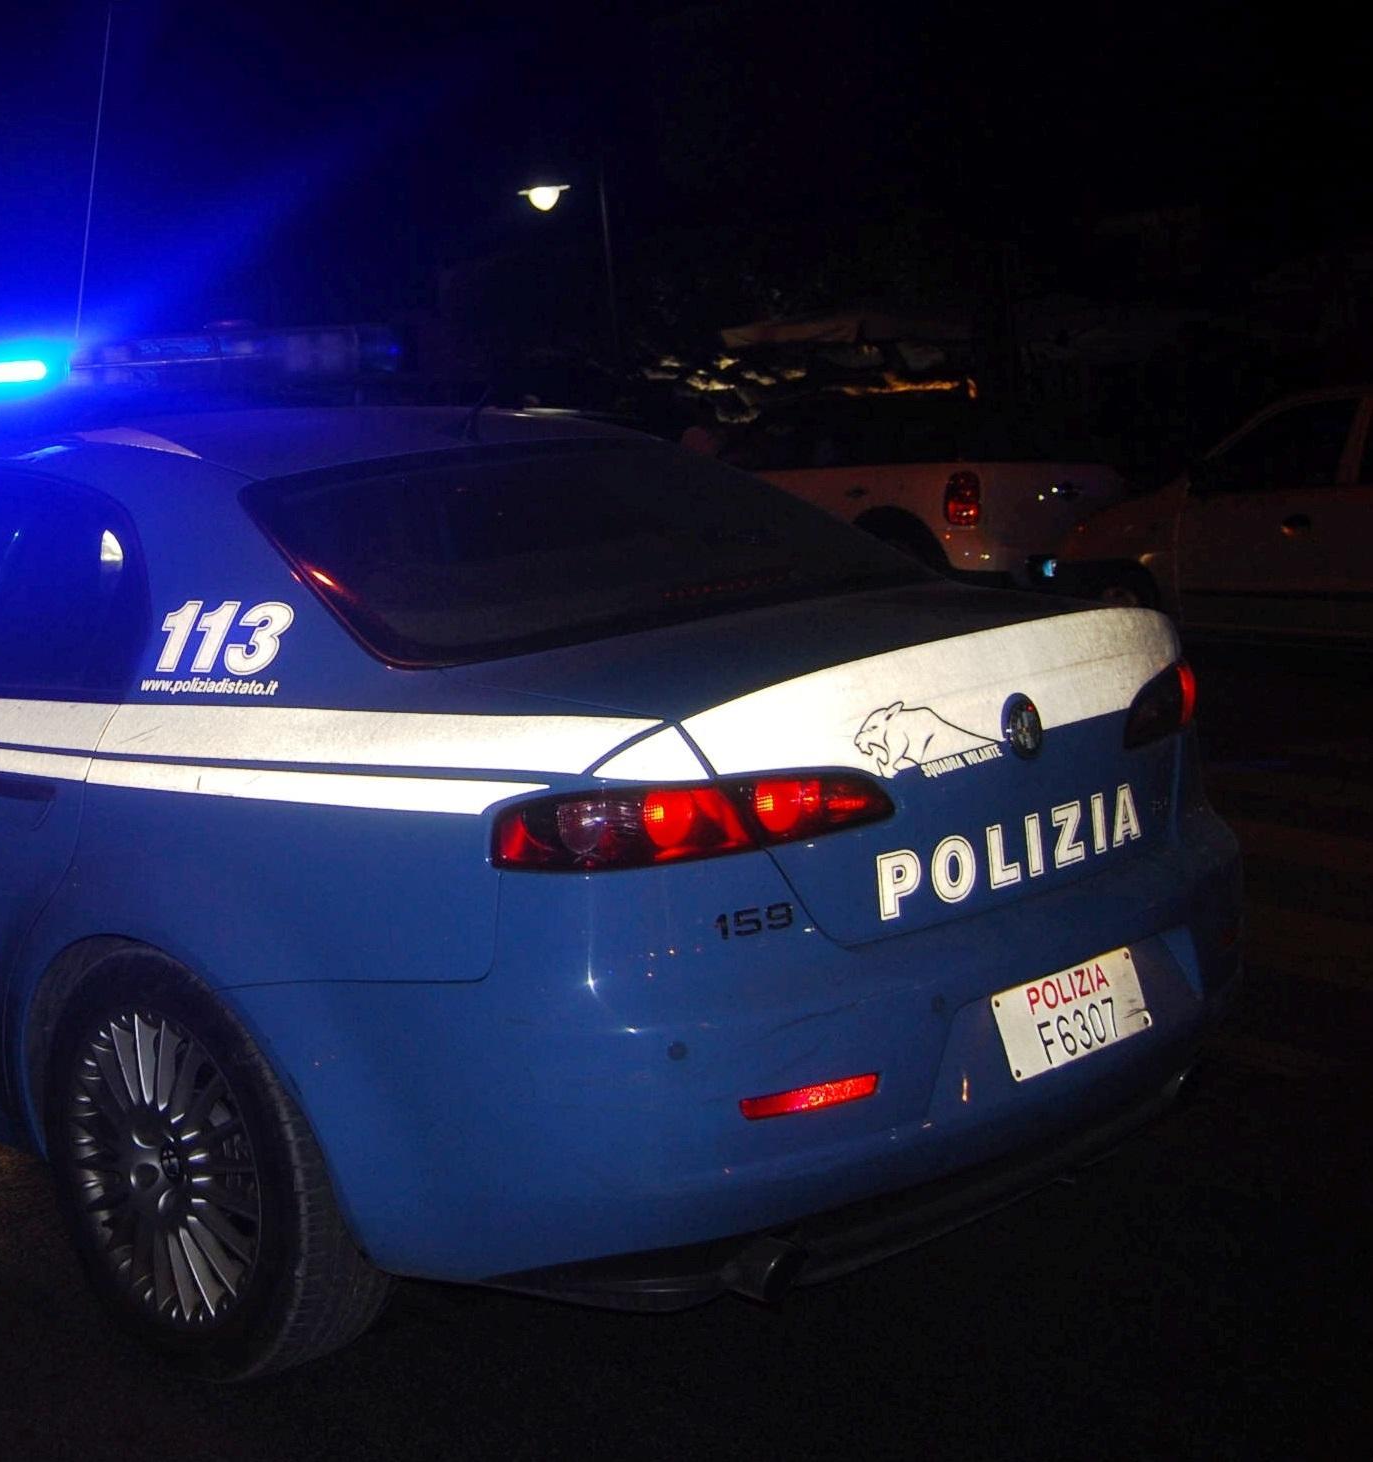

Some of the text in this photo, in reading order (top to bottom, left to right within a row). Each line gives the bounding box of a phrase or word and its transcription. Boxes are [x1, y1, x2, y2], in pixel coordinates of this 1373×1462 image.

[155, 600, 295, 676] 113
[141, 677, 279, 696] www.poliziadistato.it
[921, 744, 1003, 778] SQUADRA VOLANTE
[876, 783, 1141, 921] POLIZIA
[714, 902, 792, 940] 159
[1026, 963, 1110, 1015] POLIZIA
[1037, 997, 1118, 1065] F6307
